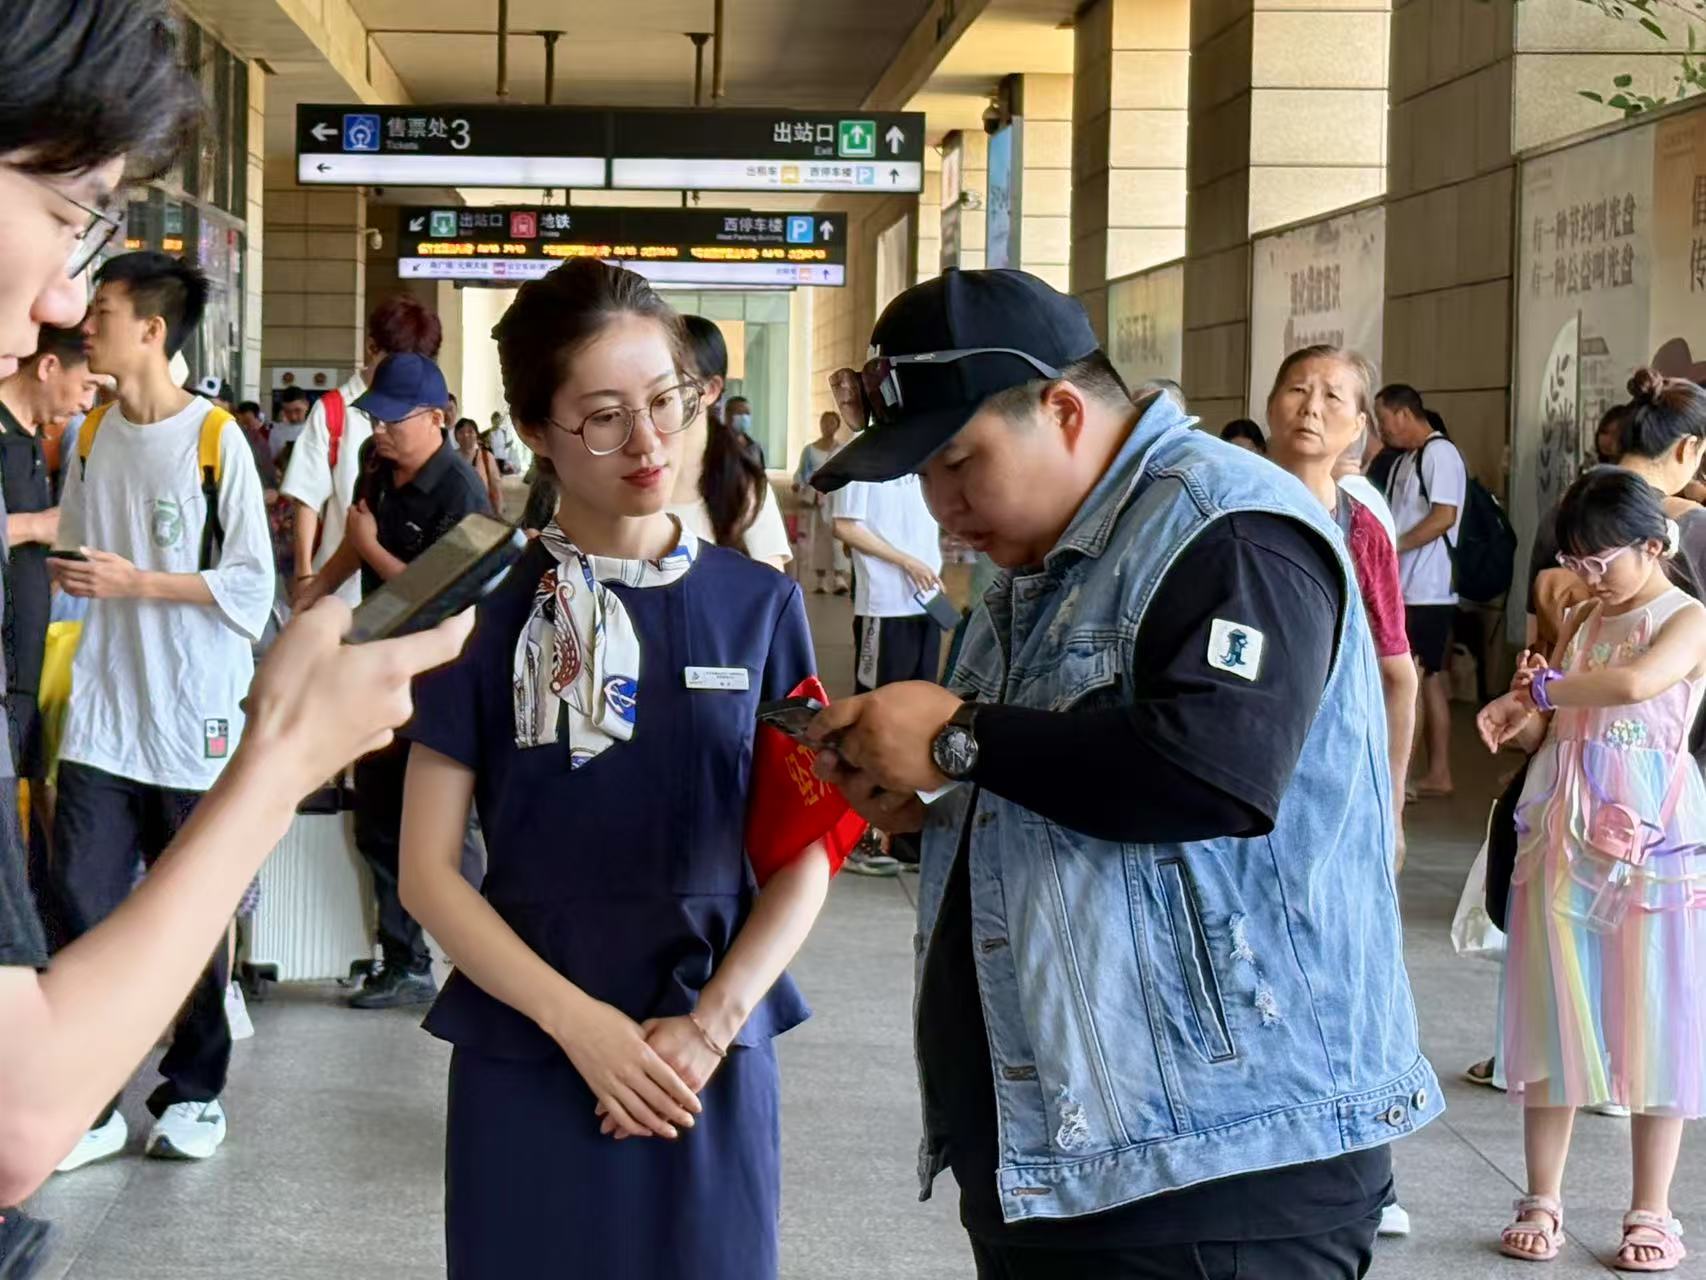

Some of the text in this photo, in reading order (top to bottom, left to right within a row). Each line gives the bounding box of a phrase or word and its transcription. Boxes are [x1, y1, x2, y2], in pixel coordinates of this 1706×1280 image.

[773, 121, 834, 143] 出站口
[814, 146, 833, 156] Exit
[459, 213, 571, 229] 出站口 地铁
[724, 217, 783, 233] 西停车楼
